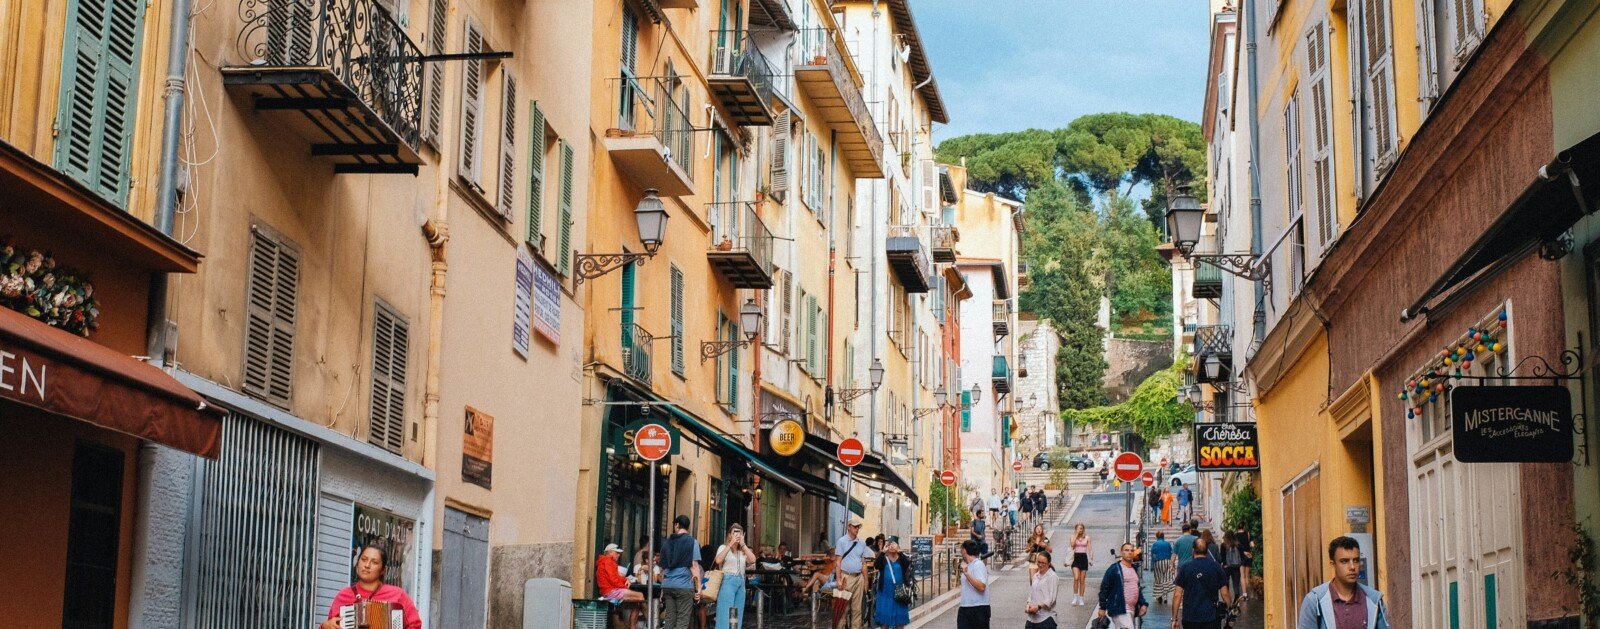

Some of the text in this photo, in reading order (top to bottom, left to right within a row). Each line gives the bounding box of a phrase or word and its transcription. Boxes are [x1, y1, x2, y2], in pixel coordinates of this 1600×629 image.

[780, 433, 795, 442] BEER
[1200, 446, 1257, 467] SOCCA
[358, 513, 381, 537] COAT
